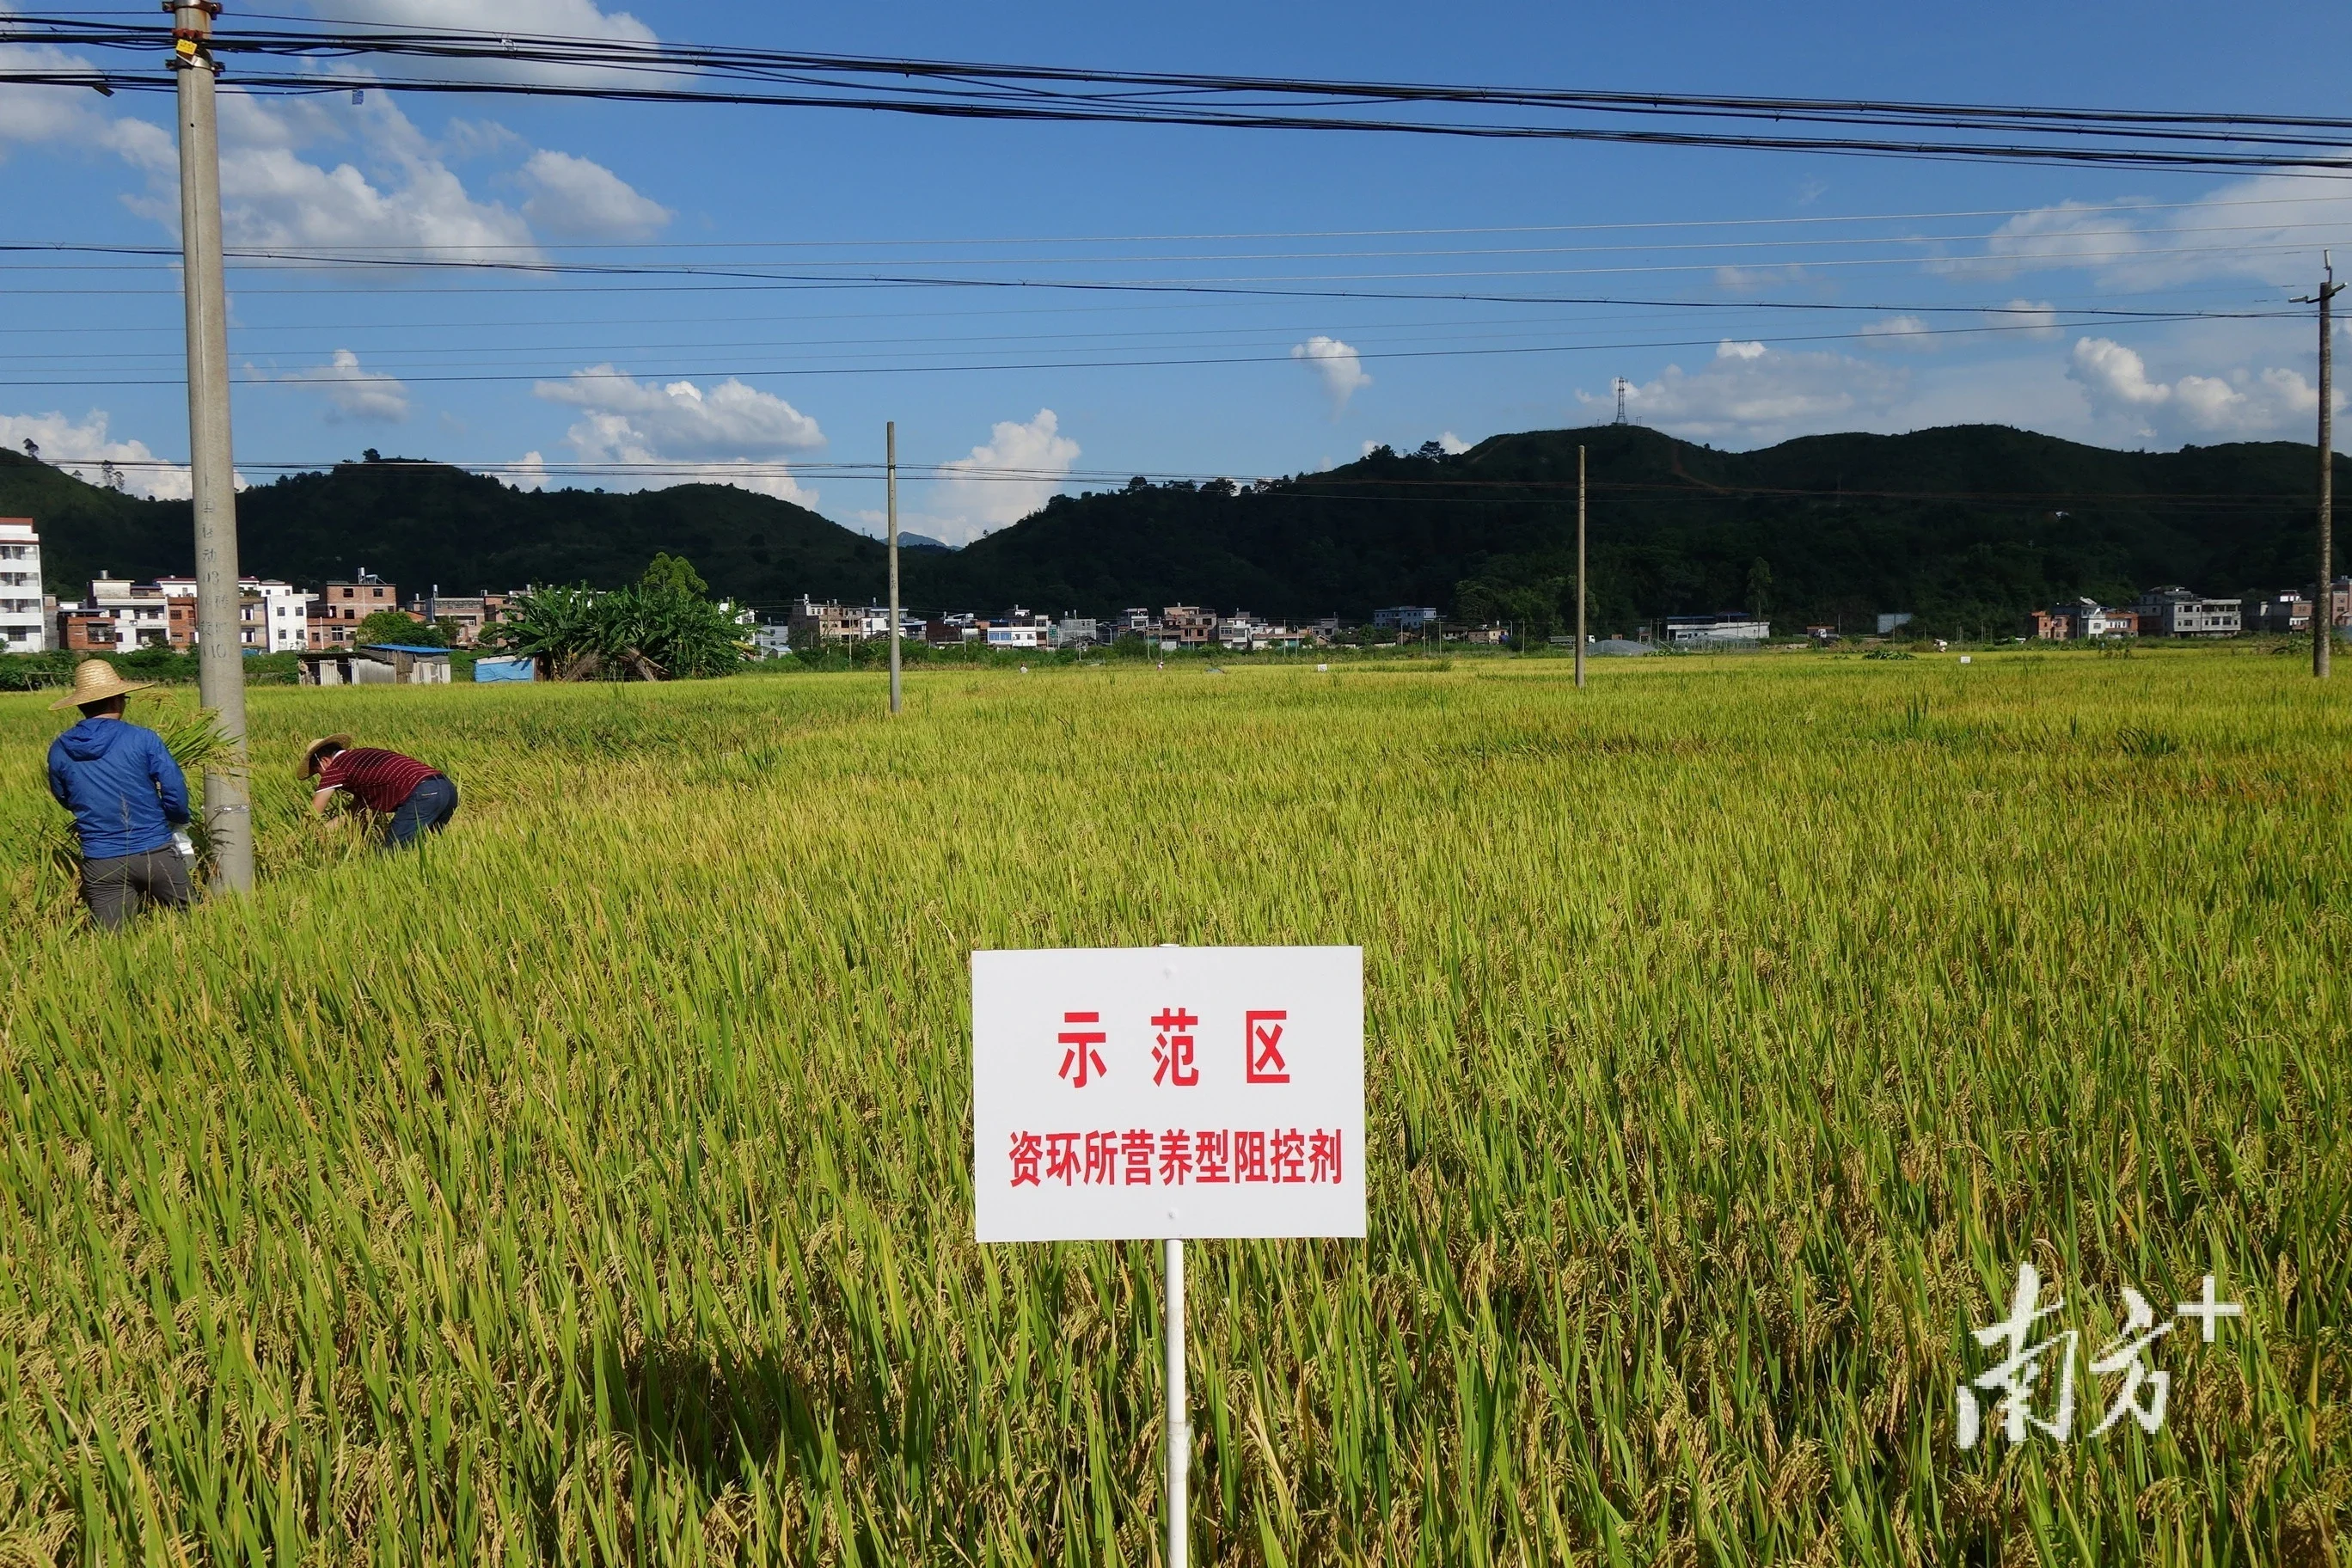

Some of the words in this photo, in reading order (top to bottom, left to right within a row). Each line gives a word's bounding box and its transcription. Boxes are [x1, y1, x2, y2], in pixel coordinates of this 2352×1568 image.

[1057, 1008, 1290, 1089] 示范区
[1008, 1128, 1343, 1187] 资环所营养型阻控剂
